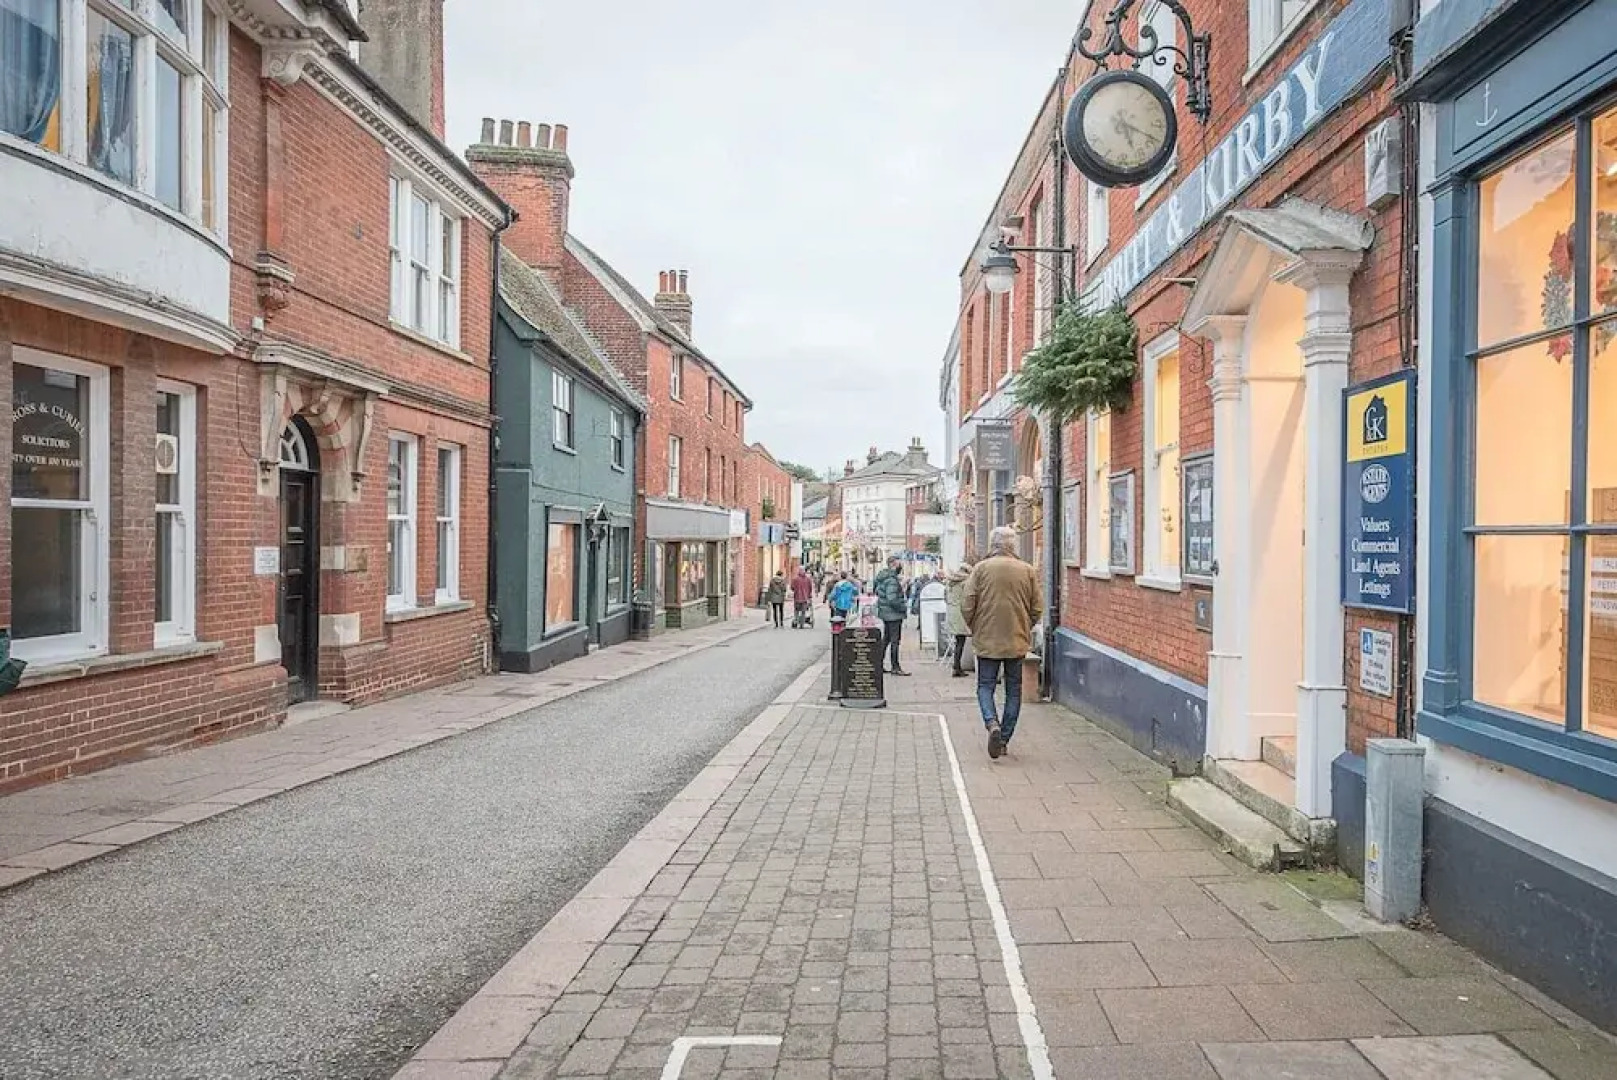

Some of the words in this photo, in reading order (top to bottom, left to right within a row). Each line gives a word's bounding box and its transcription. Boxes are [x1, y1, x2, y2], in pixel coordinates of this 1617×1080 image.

[1166, 193, 1183, 247] &
[1200, 31, 1336, 220] KIRBY
[39, 402, 49, 413] &
[22, 434, 71, 449] SOLICITORS
[1361, 516, 1391, 533] Valuers
[1352, 537, 1400, 553] Commercial
[1352, 557, 1371, 573] Land
[1373, 558, 1401, 577] Agents
[1360, 579, 1391, 599] Lettings
